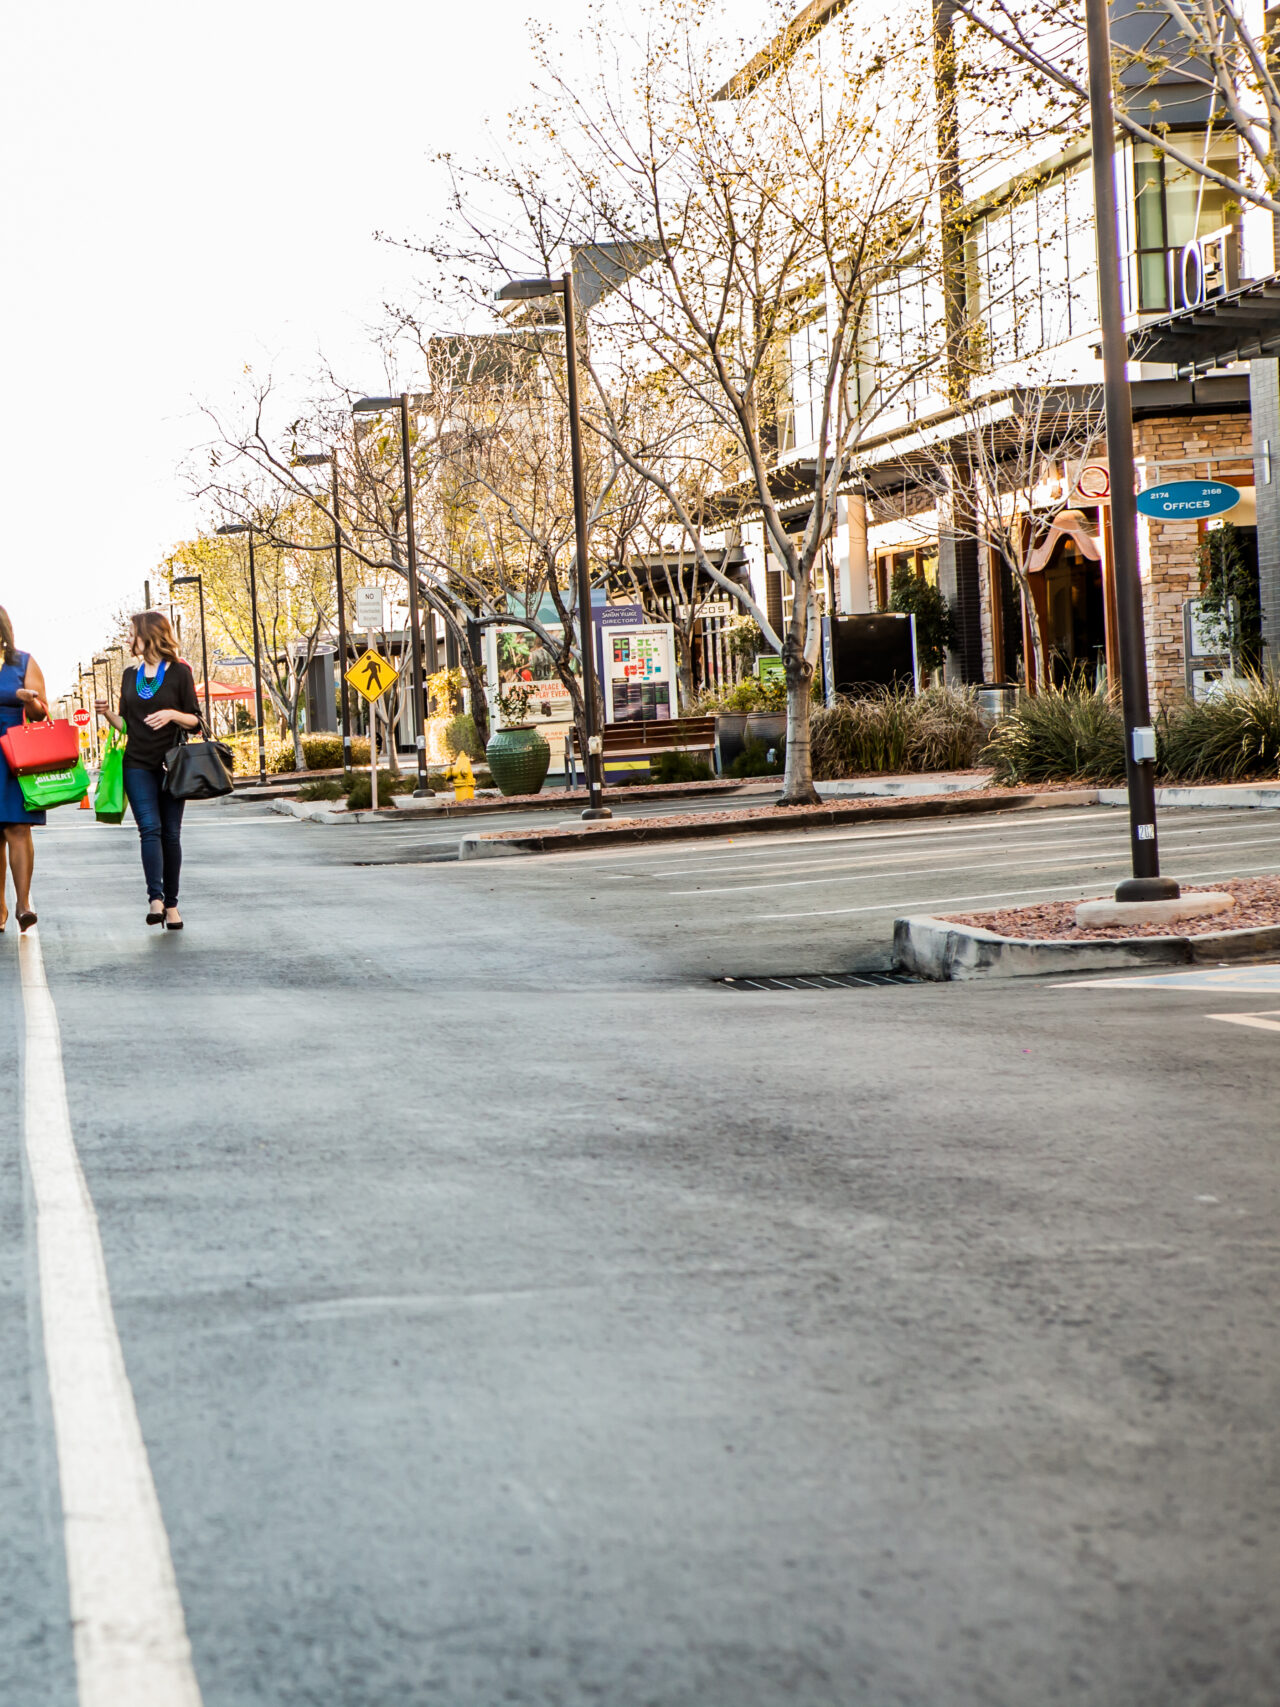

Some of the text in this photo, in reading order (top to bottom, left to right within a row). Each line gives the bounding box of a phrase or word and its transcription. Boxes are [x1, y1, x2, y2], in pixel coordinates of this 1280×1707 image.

[1150, 488, 1222, 500] 2174 2168
[1163, 500, 1211, 511] OFFICES
[74, 714, 89, 722] STOP
[37, 772, 71, 783] GILBERT
